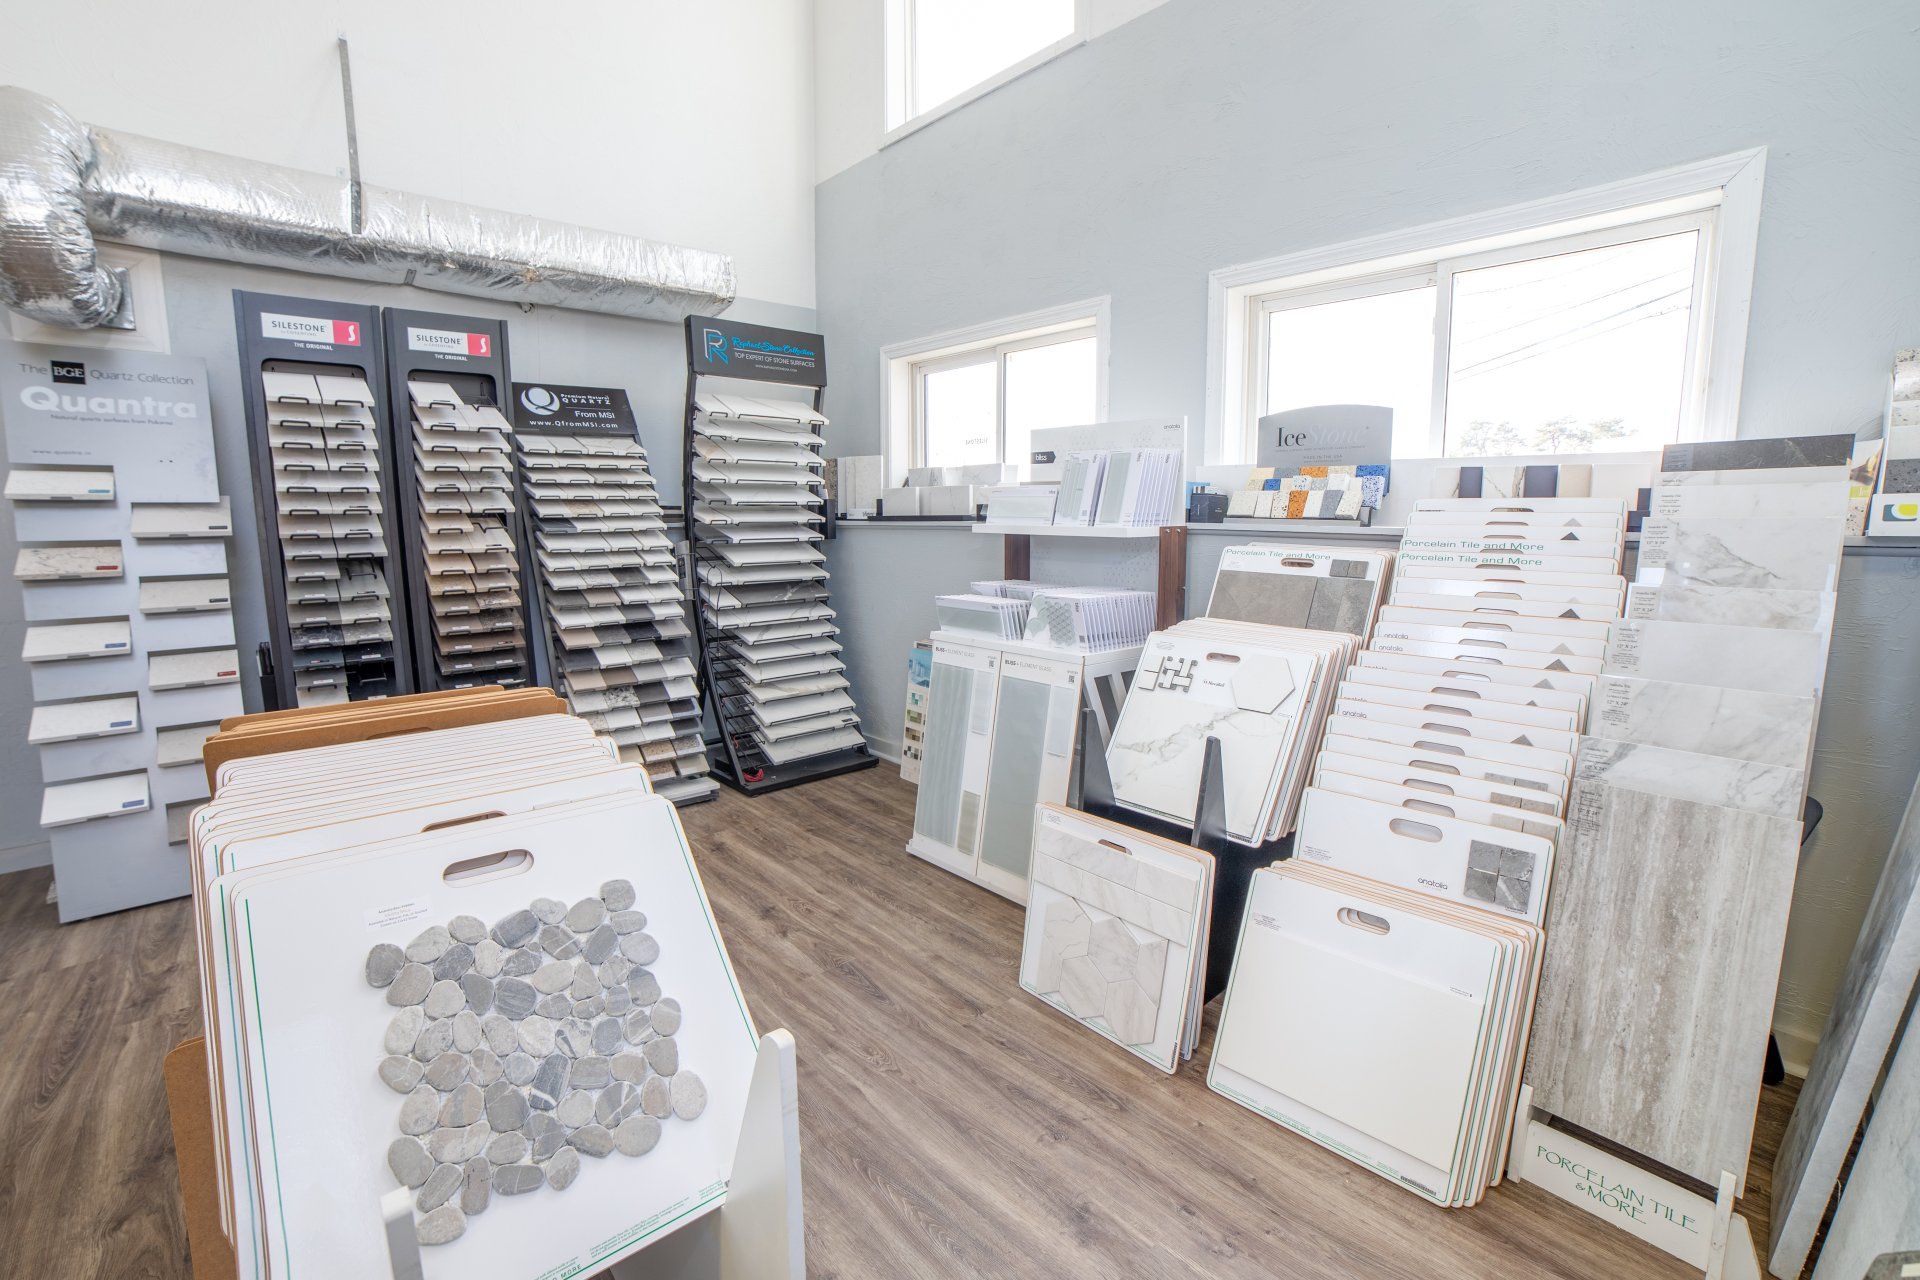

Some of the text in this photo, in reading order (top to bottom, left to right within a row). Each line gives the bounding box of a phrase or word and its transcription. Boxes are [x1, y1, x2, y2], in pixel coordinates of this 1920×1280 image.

[272, 321, 326, 333] SILESTONE
[416, 334, 462, 345] SILESTONE
[306, 343, 333, 351] ORIGINAL
[735, 352, 745, 360] TOP
[746, 354, 764, 362] EXPERT
[773, 357, 790, 365] STONE
[790, 359, 815, 368] SURFACES
[18, 363, 194, 386] The BGE Quartz Collection
[20, 386, 198, 418] Quantra
[529, 420, 619, 428] www.QfromMSI.com
[1035, 453, 1048, 461] bliss
[1404, 540, 1545, 551] Porcelain Tile and More
[1226, 548, 1266, 557] Porcelain
[1401, 553, 1543, 566] Porcelain Tile and More
[1378, 644, 1404, 652] anatolia
[1342, 710, 1368, 719] anatolia
[1417, 877, 1448, 890] anatolia
[1536, 1145, 1699, 1234] PORCELAIN TILE
[1587, 1185, 1647, 1225] MORE
